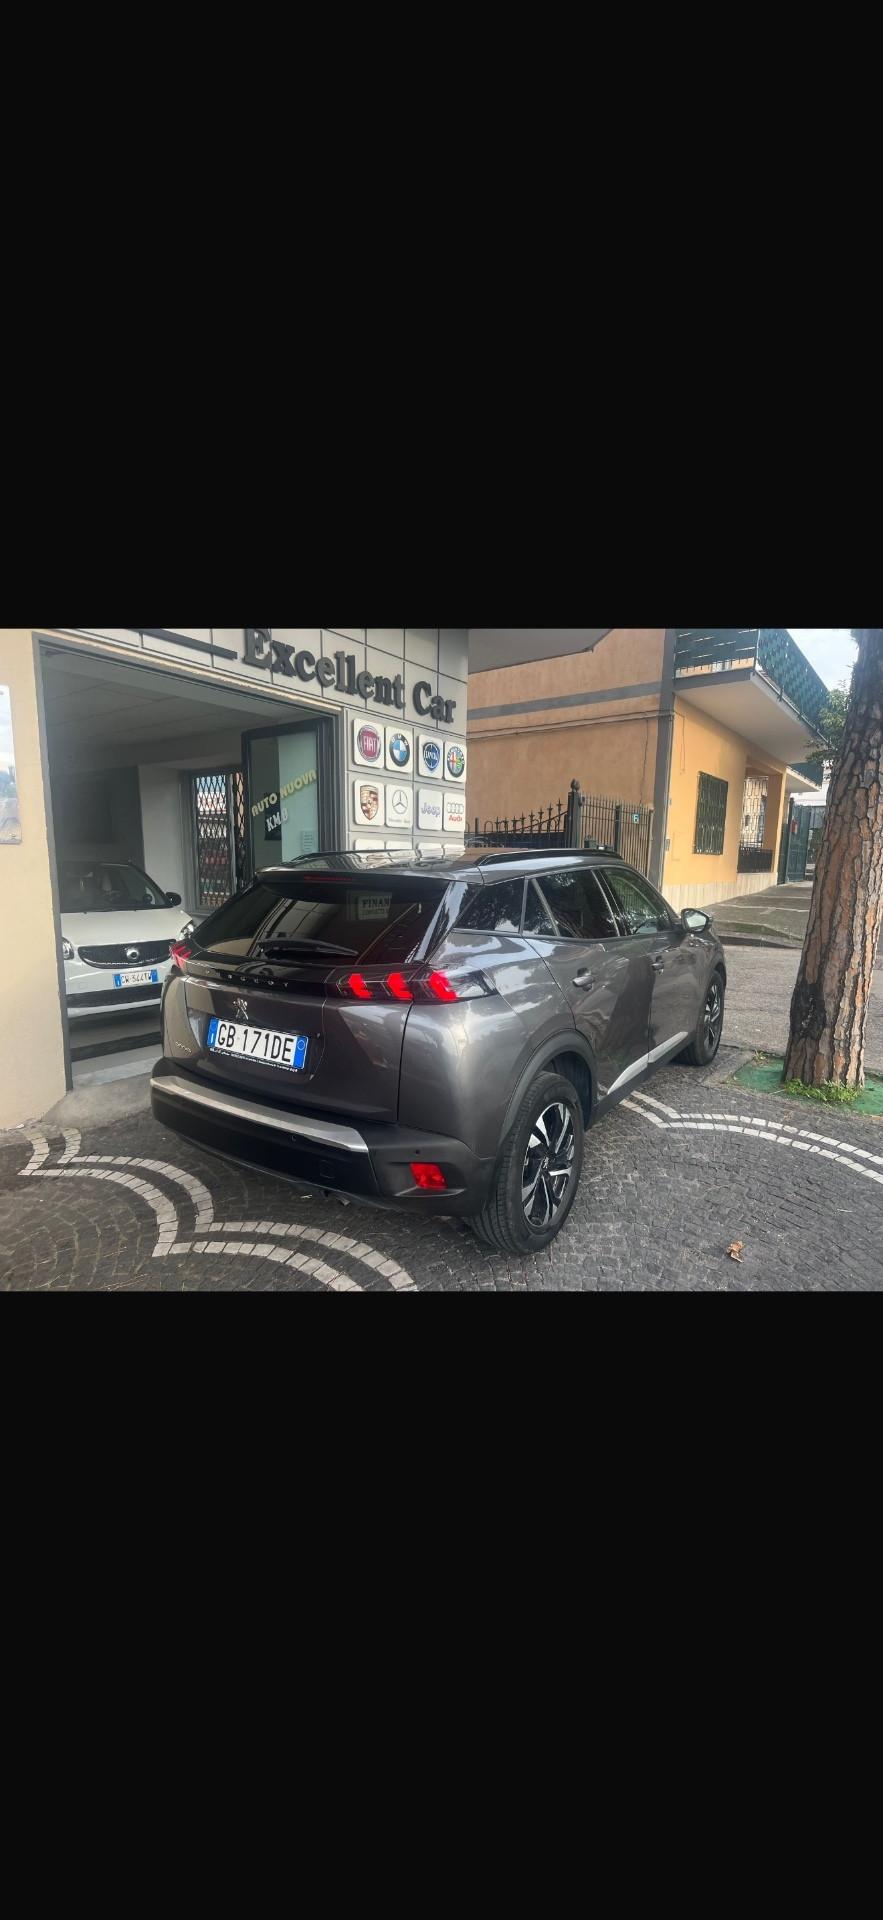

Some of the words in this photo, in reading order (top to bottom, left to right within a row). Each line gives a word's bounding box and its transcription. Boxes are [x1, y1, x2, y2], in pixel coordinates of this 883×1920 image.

[243, 629, 405, 709] Excellent
[412, 680, 457, 723] Car
[363, 735, 379, 753] FIAT
[251, 793, 277, 816] AUTO
[280, 768, 317, 798] NUOVA
[421, 802, 440, 817] Jeep
[448, 814, 462, 822] Audi
[218, 1024, 236, 1048] GB
[242, 1028, 295, 1062] 171DE
